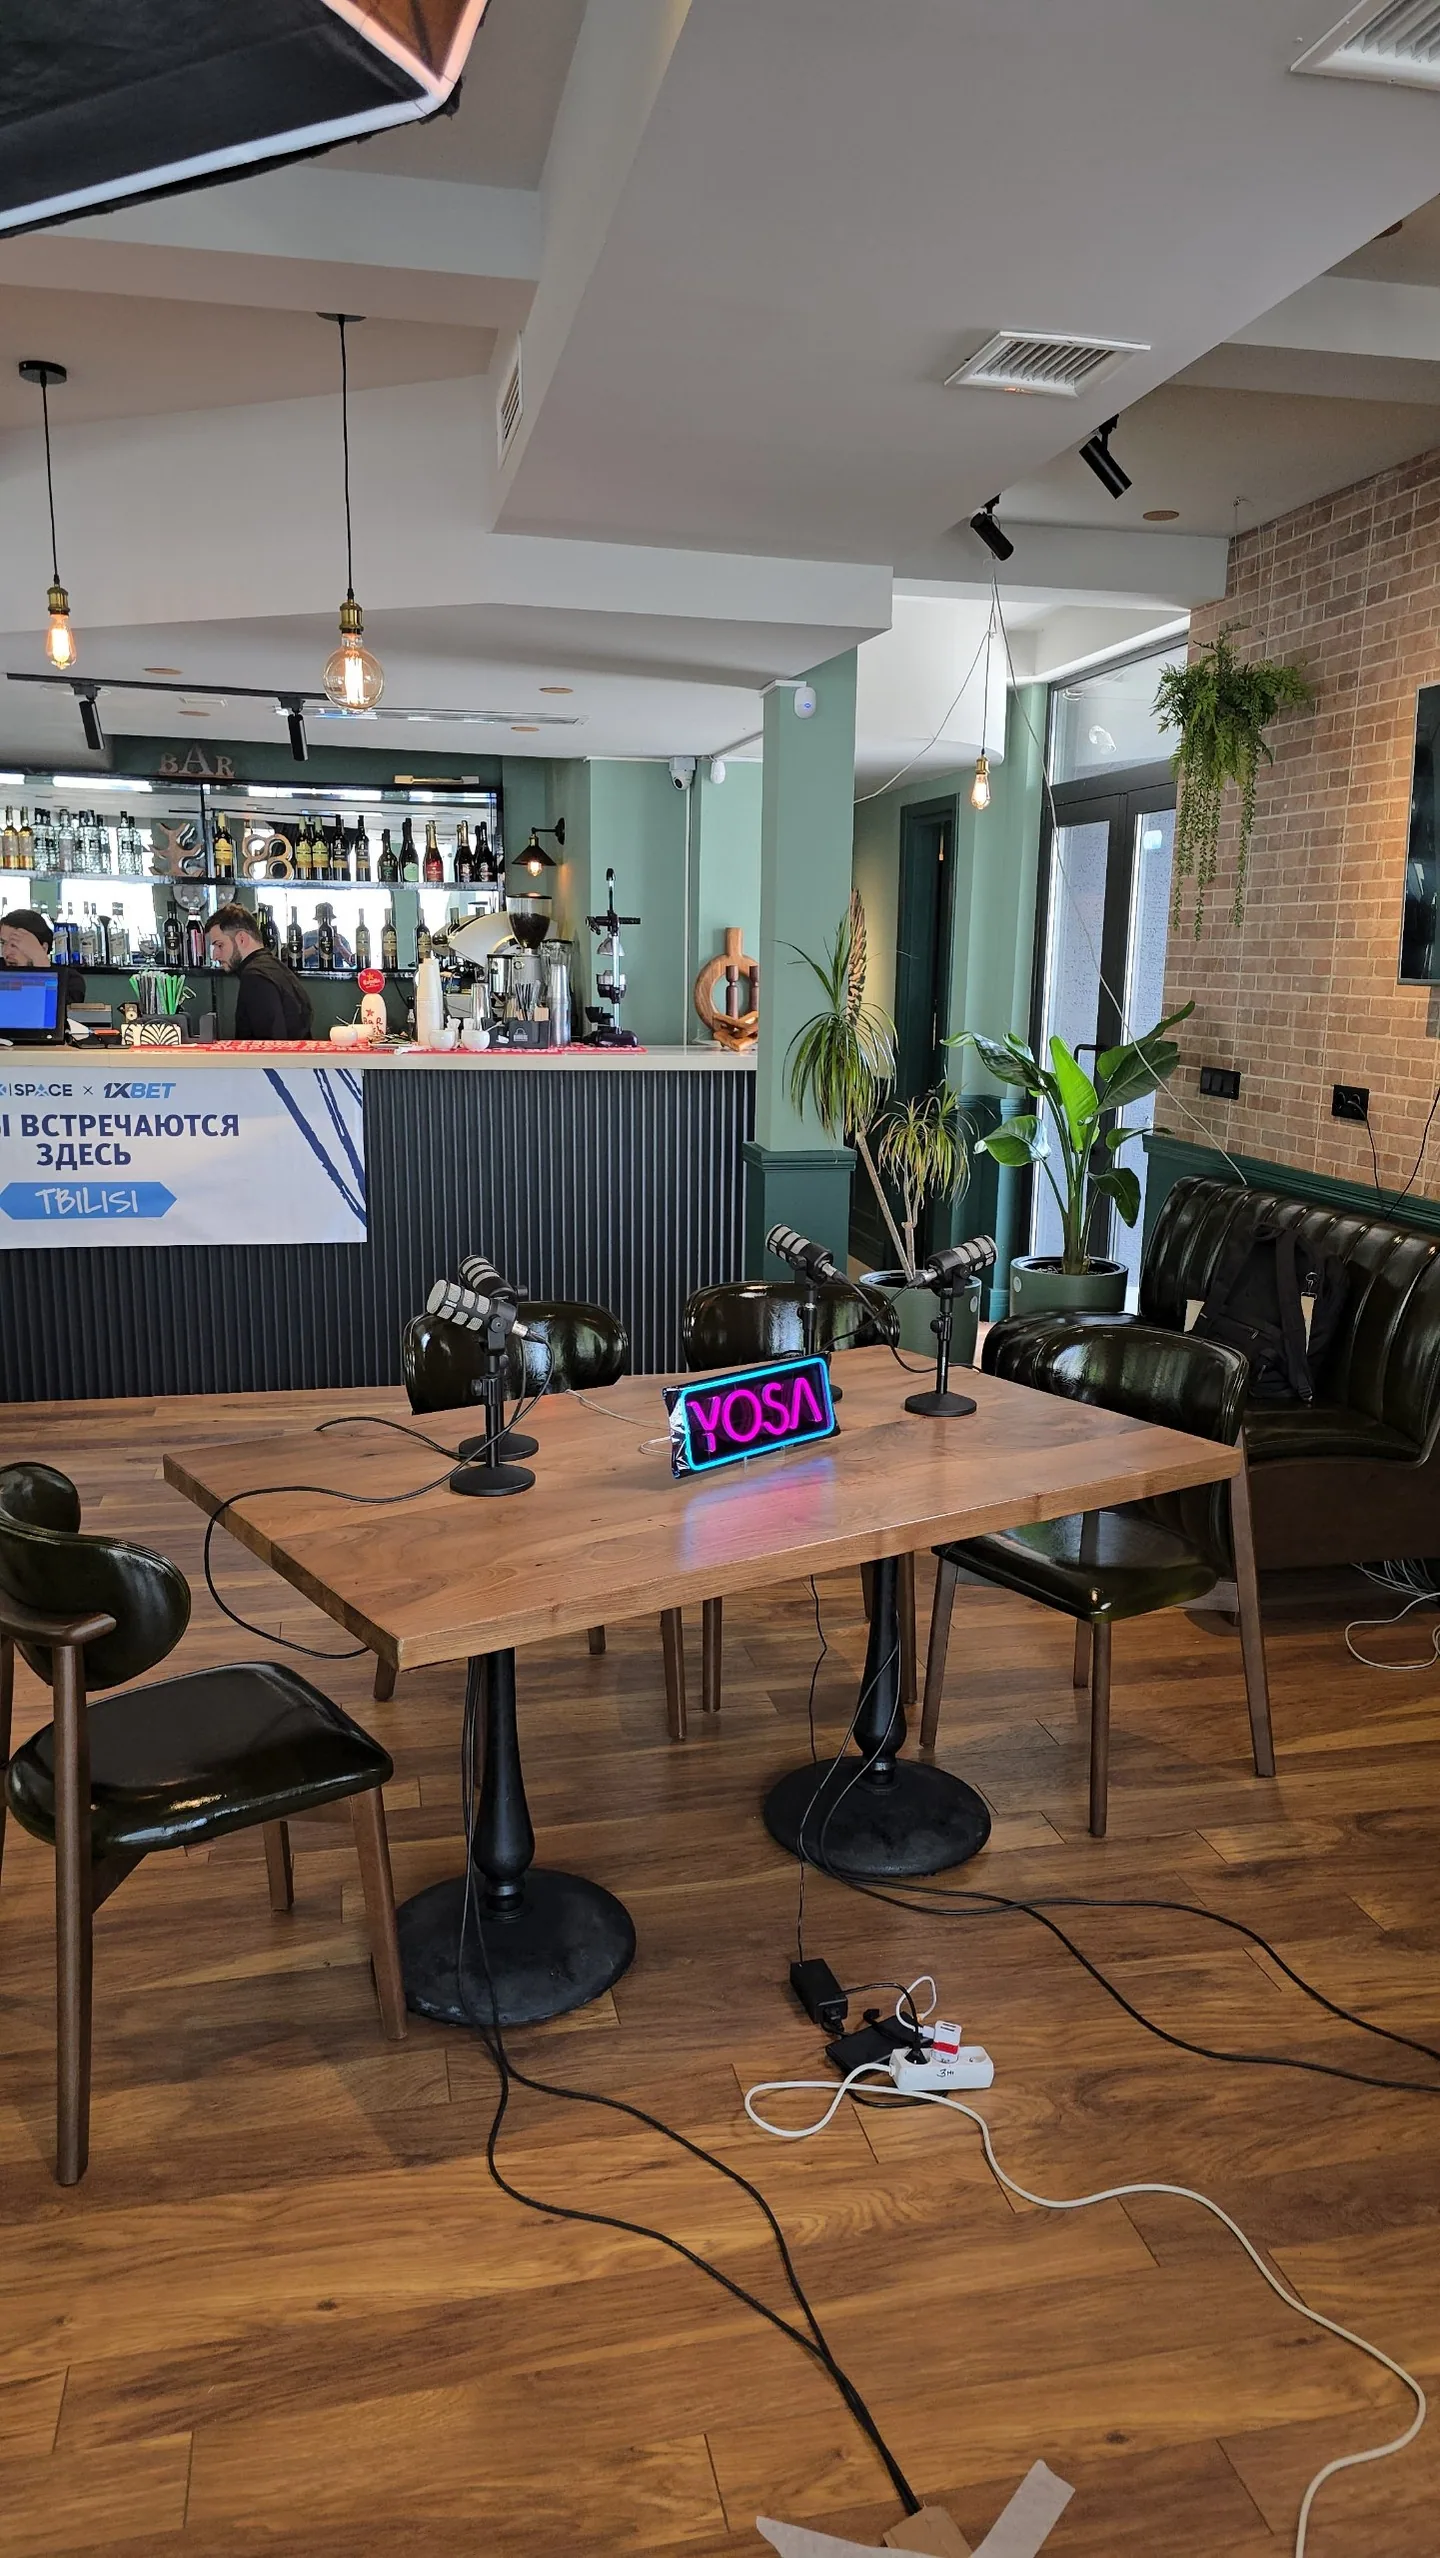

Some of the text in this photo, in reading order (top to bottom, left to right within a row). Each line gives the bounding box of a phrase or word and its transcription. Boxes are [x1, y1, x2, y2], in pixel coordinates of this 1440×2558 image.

[159, 742, 235, 776] BAR
[14, 1083, 73, 1097] SPACE
[103, 1082, 177, 1099] 1XBET
[20, 1114, 240, 1138] ВСТРЕЧАЮТСЯ
[36, 1142, 132, 1171] ЗДЕСЬ
[34, 1186, 139, 1216] TBILISI
[686, 1377, 823, 1453] YOSA
